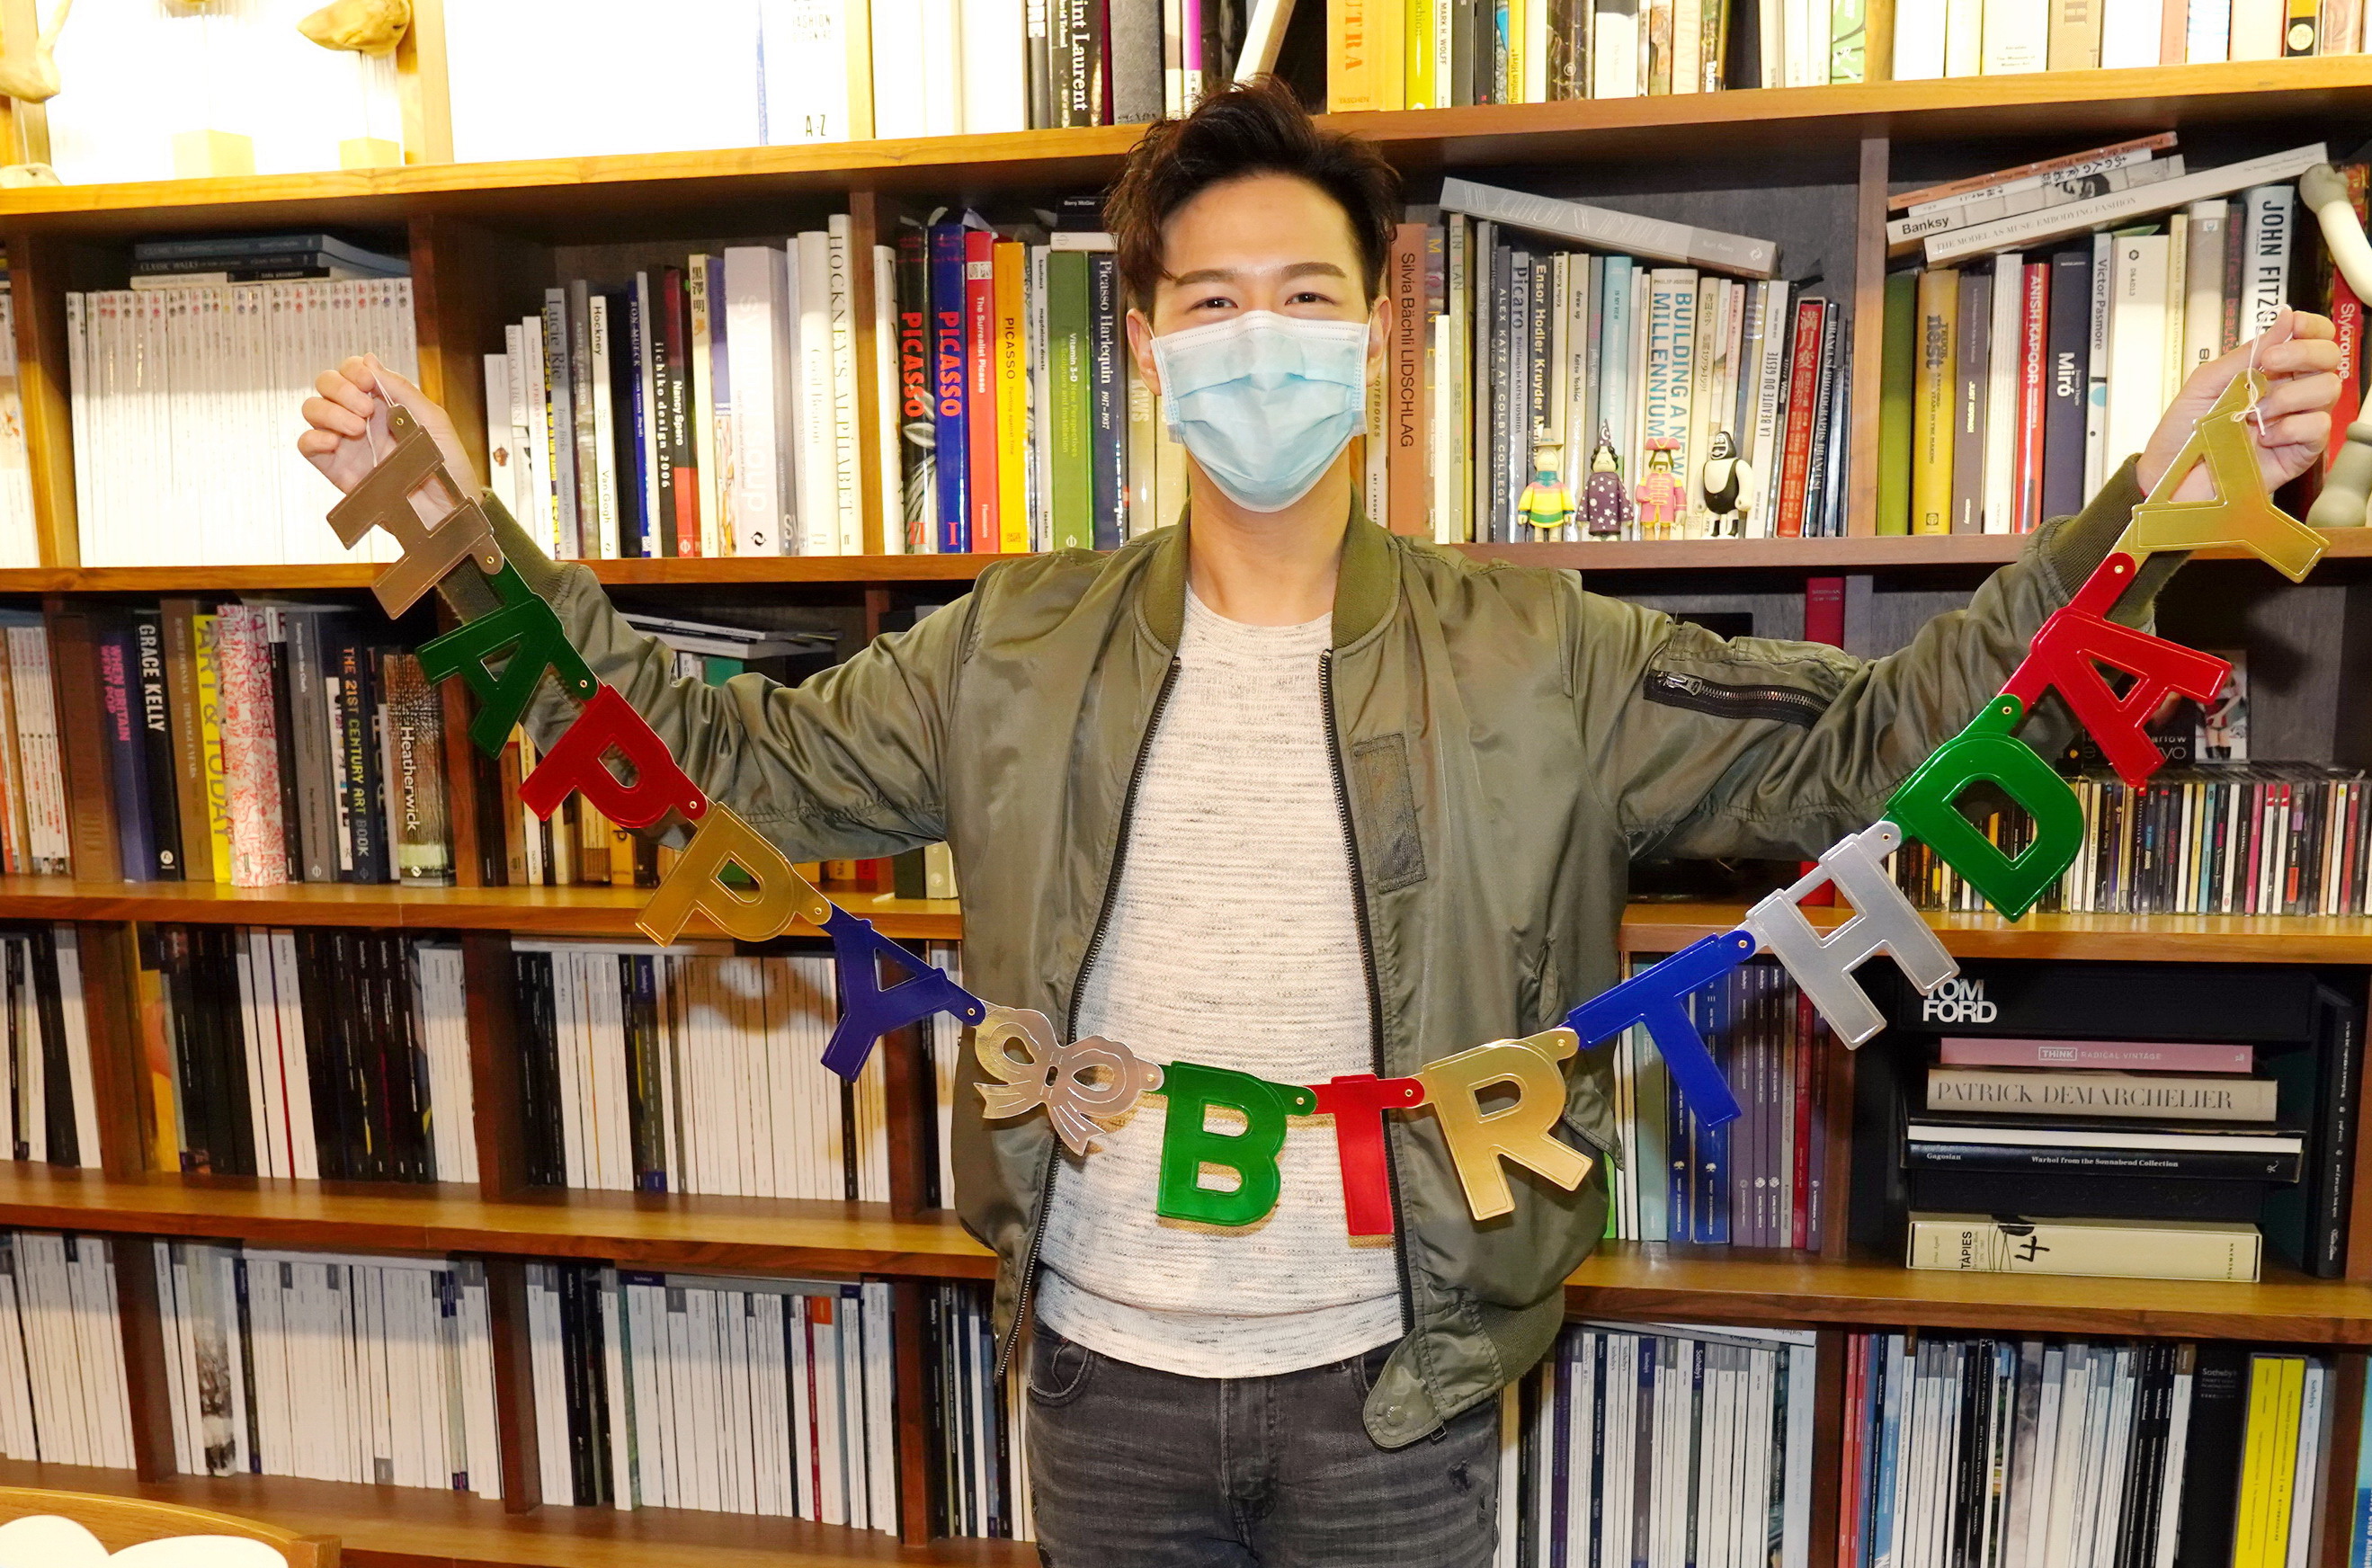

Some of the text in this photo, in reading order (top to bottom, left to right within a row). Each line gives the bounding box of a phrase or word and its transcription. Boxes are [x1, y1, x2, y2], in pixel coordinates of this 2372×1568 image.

[1439, 3, 1447, 26] MARK
[1072, 33, 1090, 111] Laurent
[1452, 225, 1463, 250] LIN
[1902, 215, 1949, 236] Banksy
[1935, 237, 1956, 251] THE
[1957, 230, 1991, 247] MODEL
[1992, 227, 2006, 239] AS
[2036, 206, 2093, 230] EMBODYING
[2094, 196, 2136, 216] FASHION
[2260, 200, 2285, 256] JOHN
[1097, 261, 1113, 383] Picasso Harlequin
[1511, 266, 1528, 329] Picaro
[2029, 275, 2042, 319] ANISH
[2094, 258, 2108, 351] Victor Pasmore
[547, 300, 564, 379] Lucie Rie
[593, 306, 602, 355] Hockney
[631, 329, 641, 367] MUECK
[976, 297, 987, 393] The Surrealist Picasso
[1004, 317, 1016, 379] PICASSO
[1069, 333, 1077, 365] Vitamin
[1400, 253, 1414, 448] Silvia Bächli LIDSCHLAG
[1514, 337, 1522, 369] Paintings
[1532, 264, 1547, 410] Ensor Hodler Kruyder
[1670, 292, 1692, 397] BUILDING
[1926, 315, 1943, 370] nest
[2027, 323, 2040, 384] KAPOOR
[2222, 298, 2239, 354] beauty
[507, 328, 520, 382] REBECCA
[828, 235, 853, 516] HOCKNEY'S ALPHABET
[902, 311, 924, 417] PICASSO
[938, 311, 961, 417] PICASSO
[1060, 348, 1068, 387] Sculpture
[1646, 292, 1671, 438] MILLENNIUM
[1766, 352, 1779, 376] GESTE
[2056, 352, 2074, 397] Miró
[1007, 387, 1015, 412] Painting
[1131, 379, 1149, 422] KAWS
[1497, 289, 1507, 505] ALEX KATZ AT COLBY COLLEGE
[1764, 378, 1775, 389] DU
[1816, 369, 1833, 441] PHOTOGRAPHS
[1967, 381, 1975, 400] JUST
[655, 342, 670, 488] iichiko design 2006
[672, 380, 683, 446] Nancy Spero
[1069, 405, 1078, 458] Perspectives
[1670, 405, 1688, 419] A
[1759, 426, 1769, 437] LA
[741, 429, 768, 512] soup
[1813, 443, 1824, 490] BRANCUSI
[601, 470, 611, 523] Van Gogh
[100, 645, 115, 714] WENT POP
[139, 624, 165, 732] GRACE KELLY
[197, 628, 219, 690] ART
[111, 645, 130, 742] WHEN BRITAIN
[203, 702, 222, 727] &
[327, 423, 982, 1084] HAPPY
[343, 647, 369, 857] THE 21ST CENTURY ART BOOK
[401, 726, 420, 831] Heatherwick
[1157, 371, 2330, 1236] BIRTHDAY
[1922, 1000, 1998, 1023] FORD
[1924, 978, 1985, 1001] TOM
[2041, 1048, 2162, 1061] THINK RADICAL VINTAGE
[1937, 1082, 2234, 1110] PATRICK DEMARCHELIER
[1926, 1152, 1962, 1162] Gagosian
[2031, 1155, 2180, 1170] Warhol from the Sonnabend Collection
[1958, 1231, 1972, 1269] TÀPIES
[1694, 1349, 1703, 1380] Sotheby's
[2308, 1379, 2317, 1408] Sotheby's
